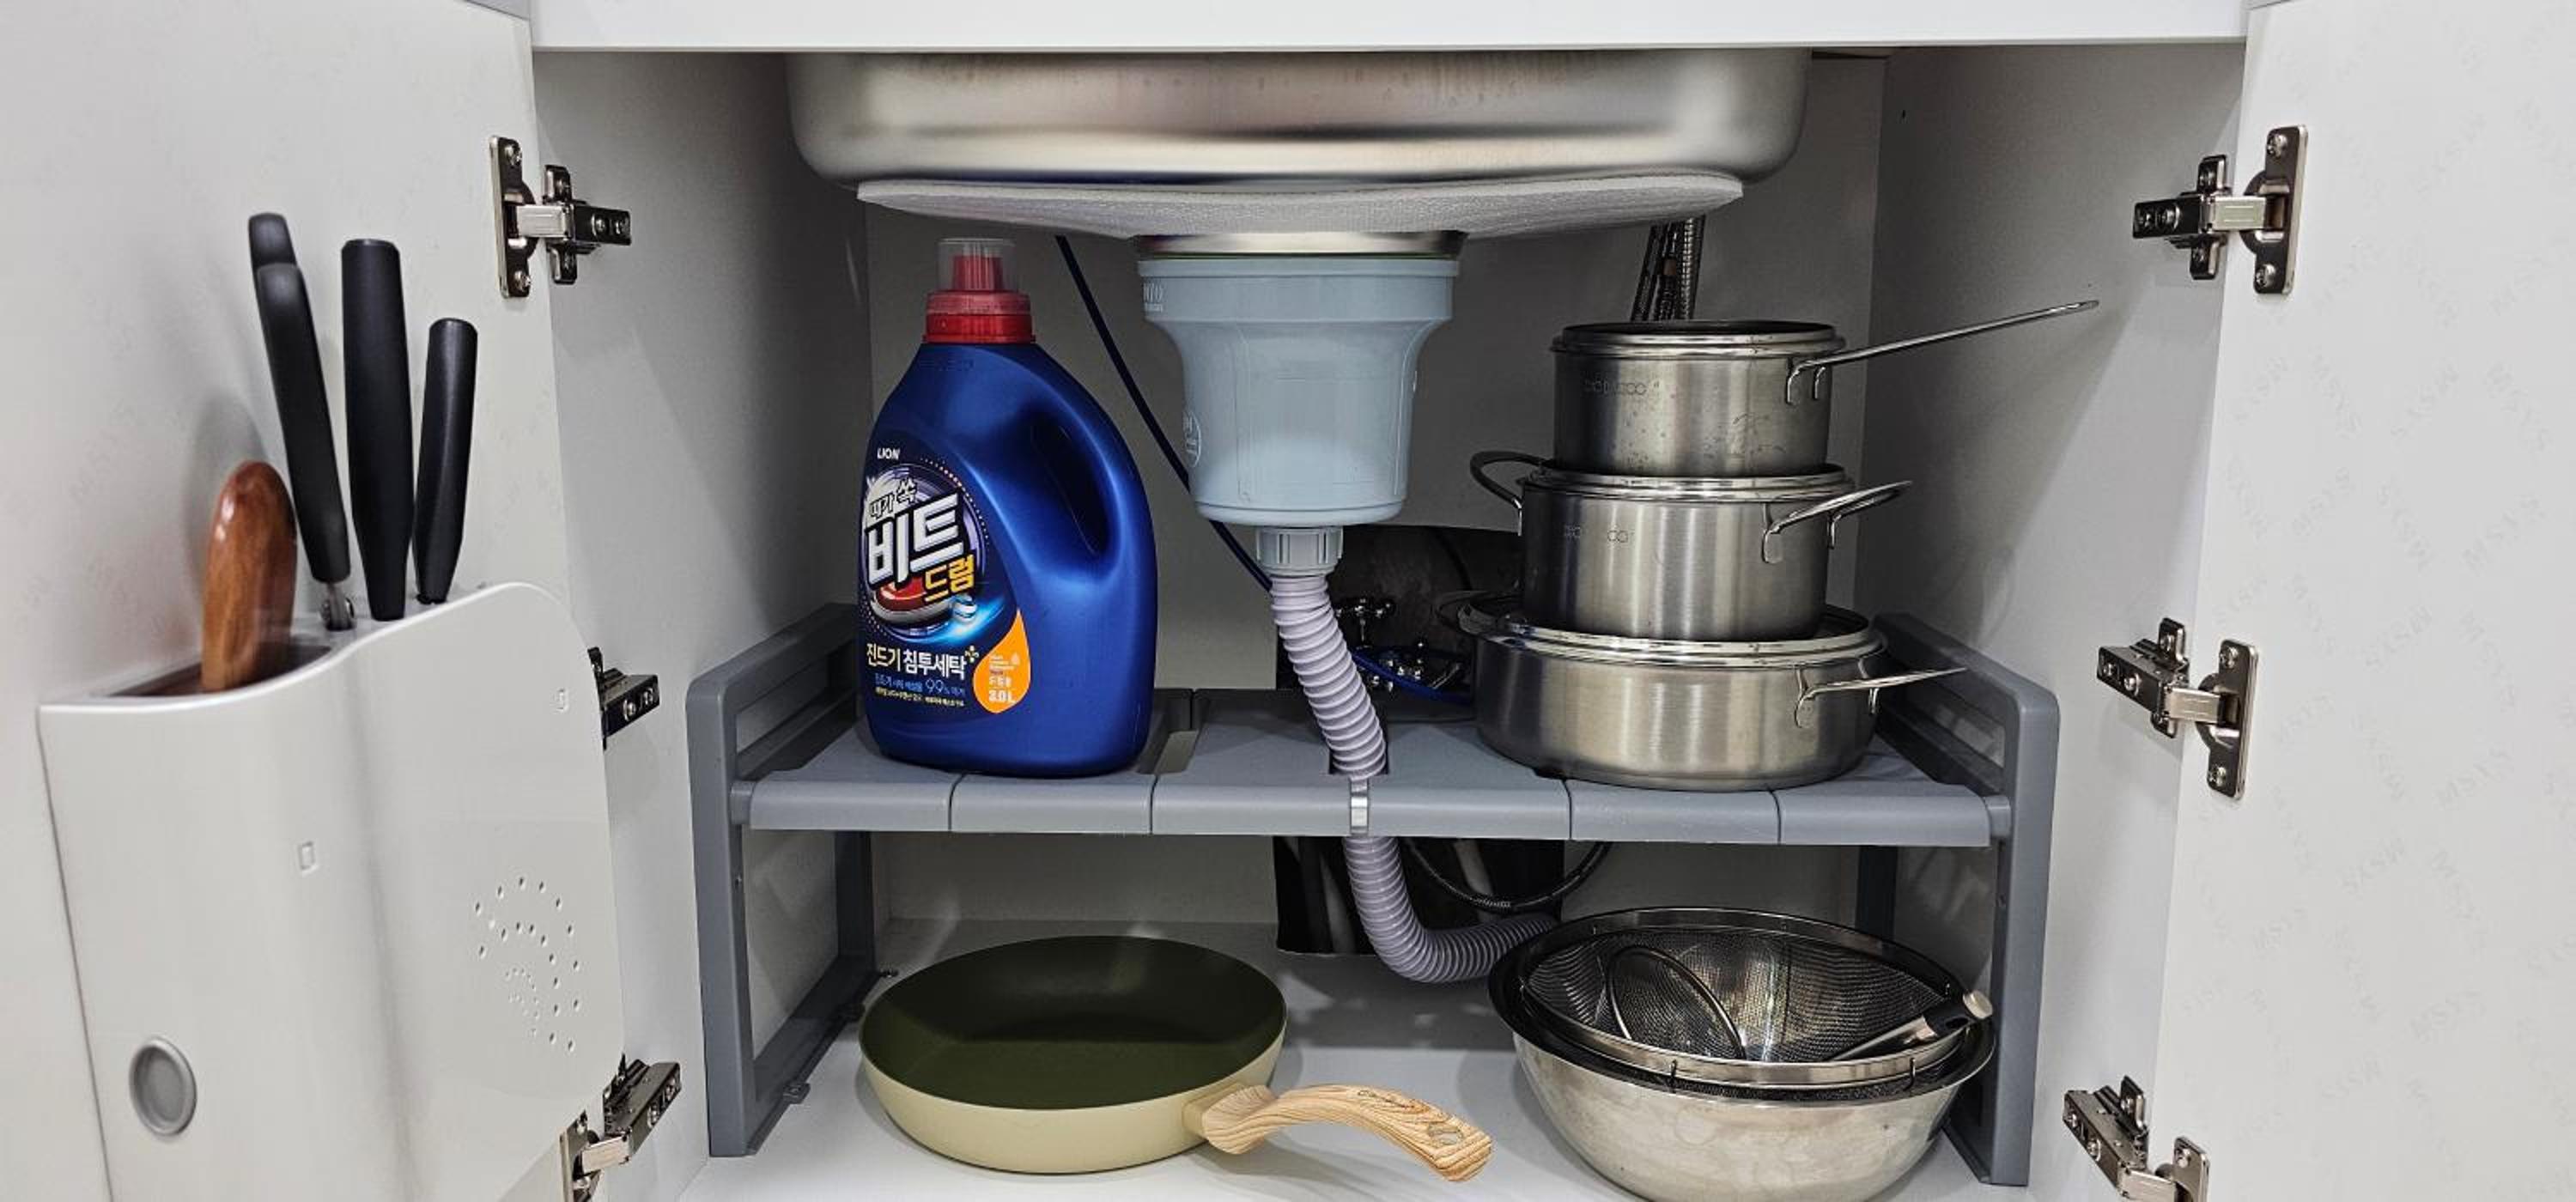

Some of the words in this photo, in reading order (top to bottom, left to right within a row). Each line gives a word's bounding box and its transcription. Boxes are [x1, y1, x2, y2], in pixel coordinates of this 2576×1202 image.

[877, 447, 901, 460] LION
[867, 491, 964, 585] 비트
[925, 554, 975, 602] 드럼
[866, 643, 901, 671] 진드기
[903, 649, 967, 680] 침투세탁
